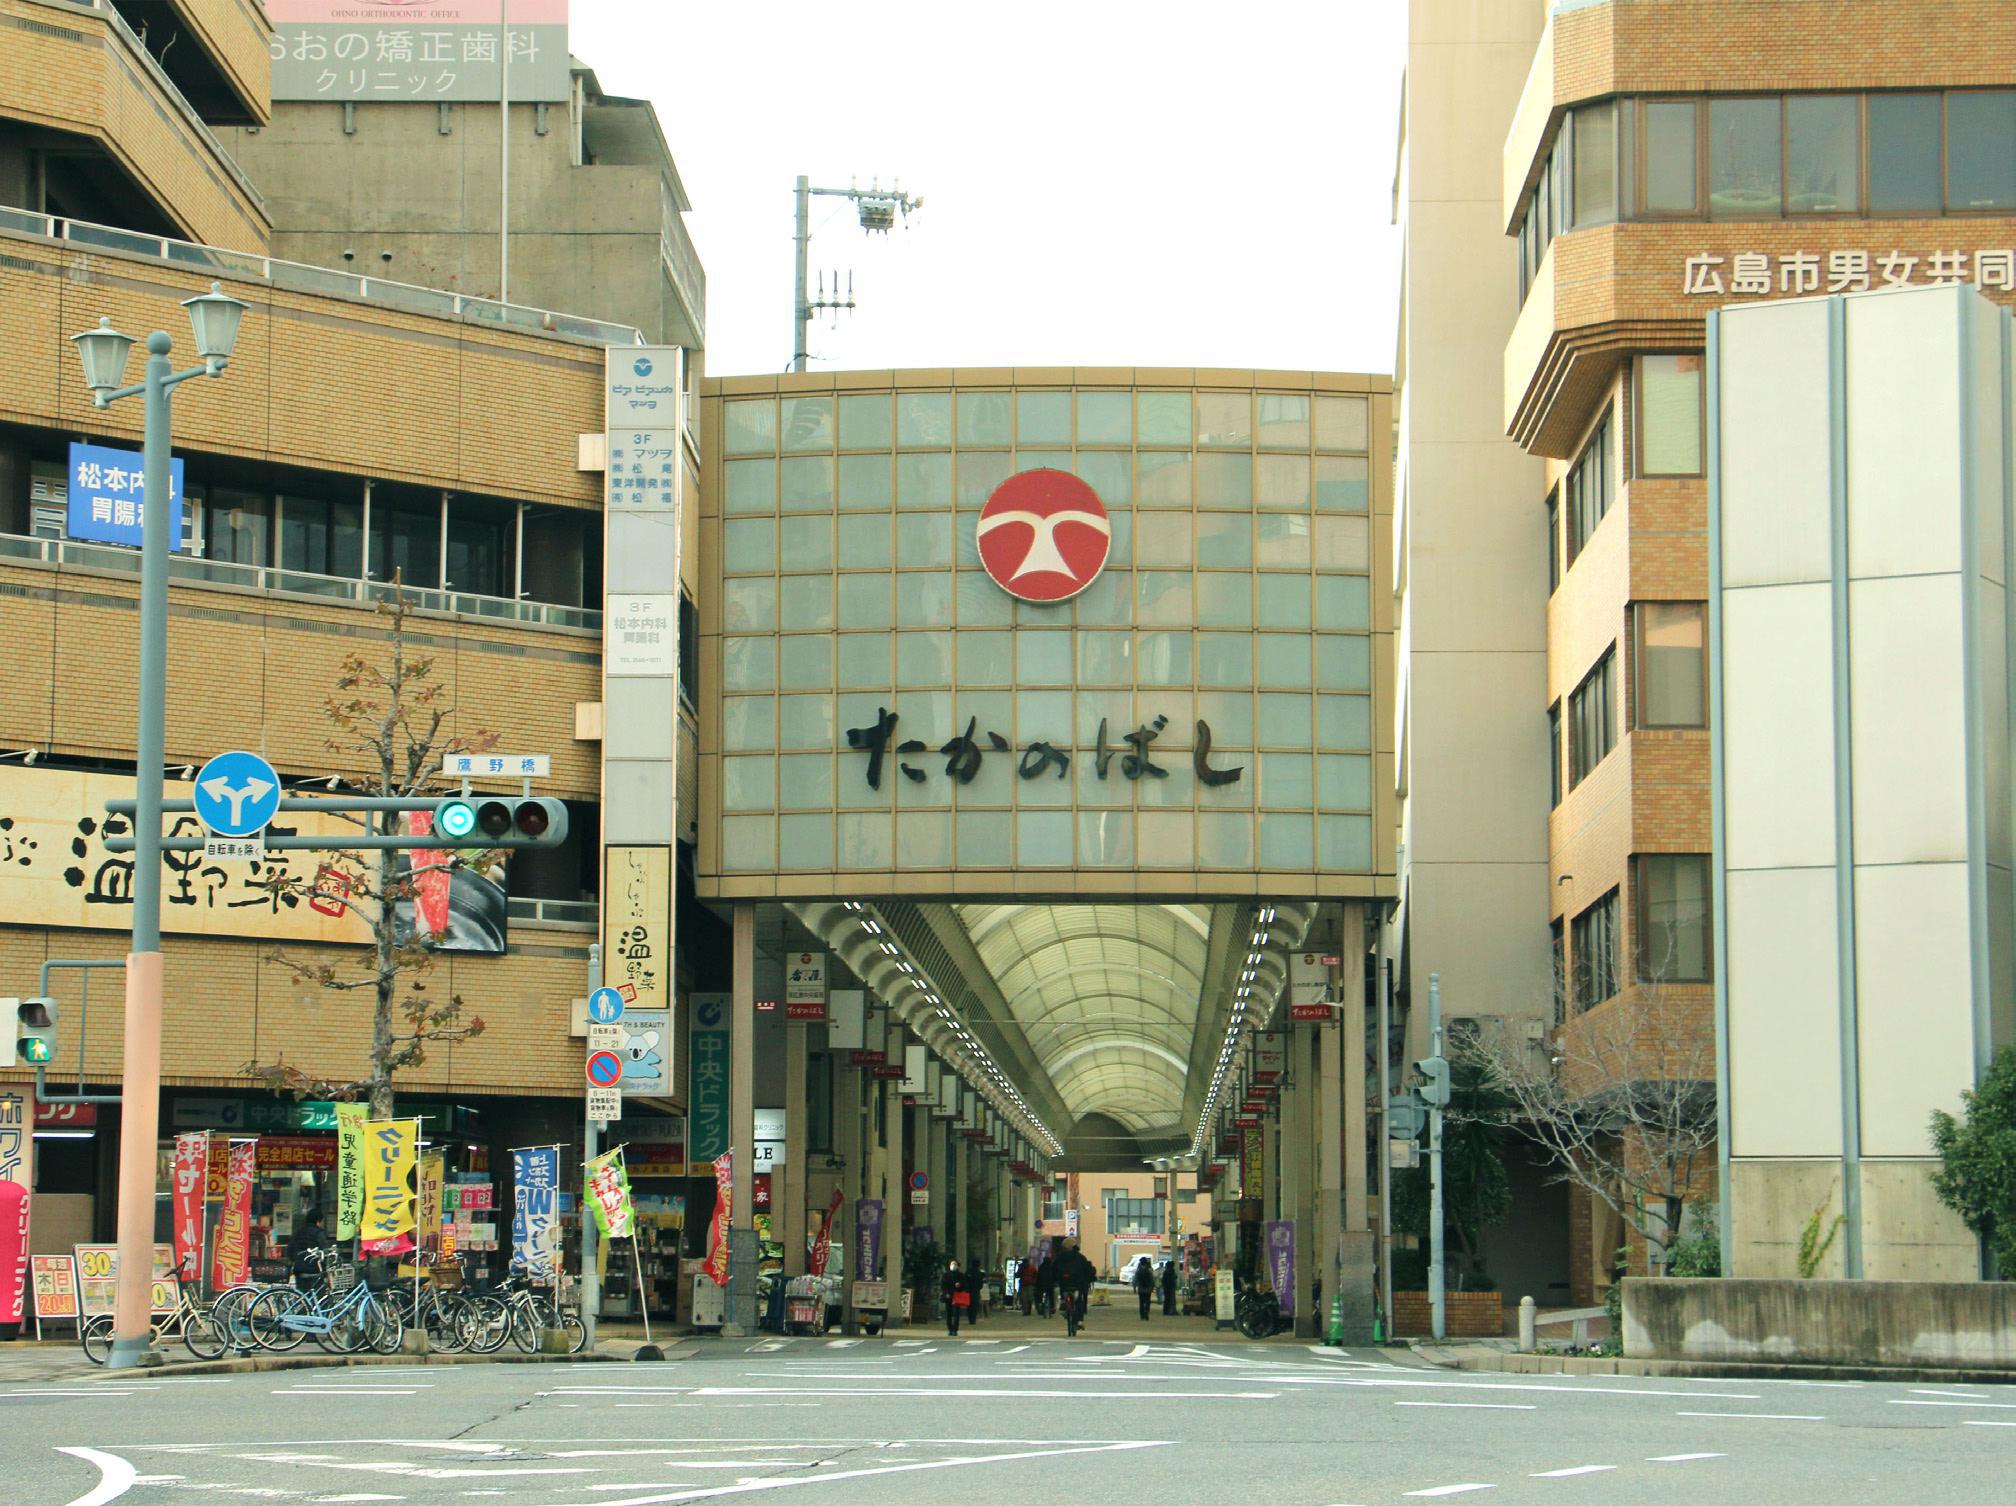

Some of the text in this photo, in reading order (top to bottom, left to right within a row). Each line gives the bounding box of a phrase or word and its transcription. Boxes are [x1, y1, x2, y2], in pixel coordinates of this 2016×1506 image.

[331, 9, 461, 18] OHNO ORTHODONTIC OFFICE
[315, 67, 458, 94] クリニック
[1682, 249, 2015, 295] 広島市男女共同
[633, 433, 653, 446] 3F
[77, 461, 176, 500] 松本内
[629, 602, 653, 614] 3F
[613, 617, 668, 630] 松本内科
[845, 706, 1244, 791] たかのばし
[457, 758, 537, 773] 鷹野橋
[640, 1021, 665, 1029] BEAUTY
[257, 1146, 335, 1163] 完全閉店セール
